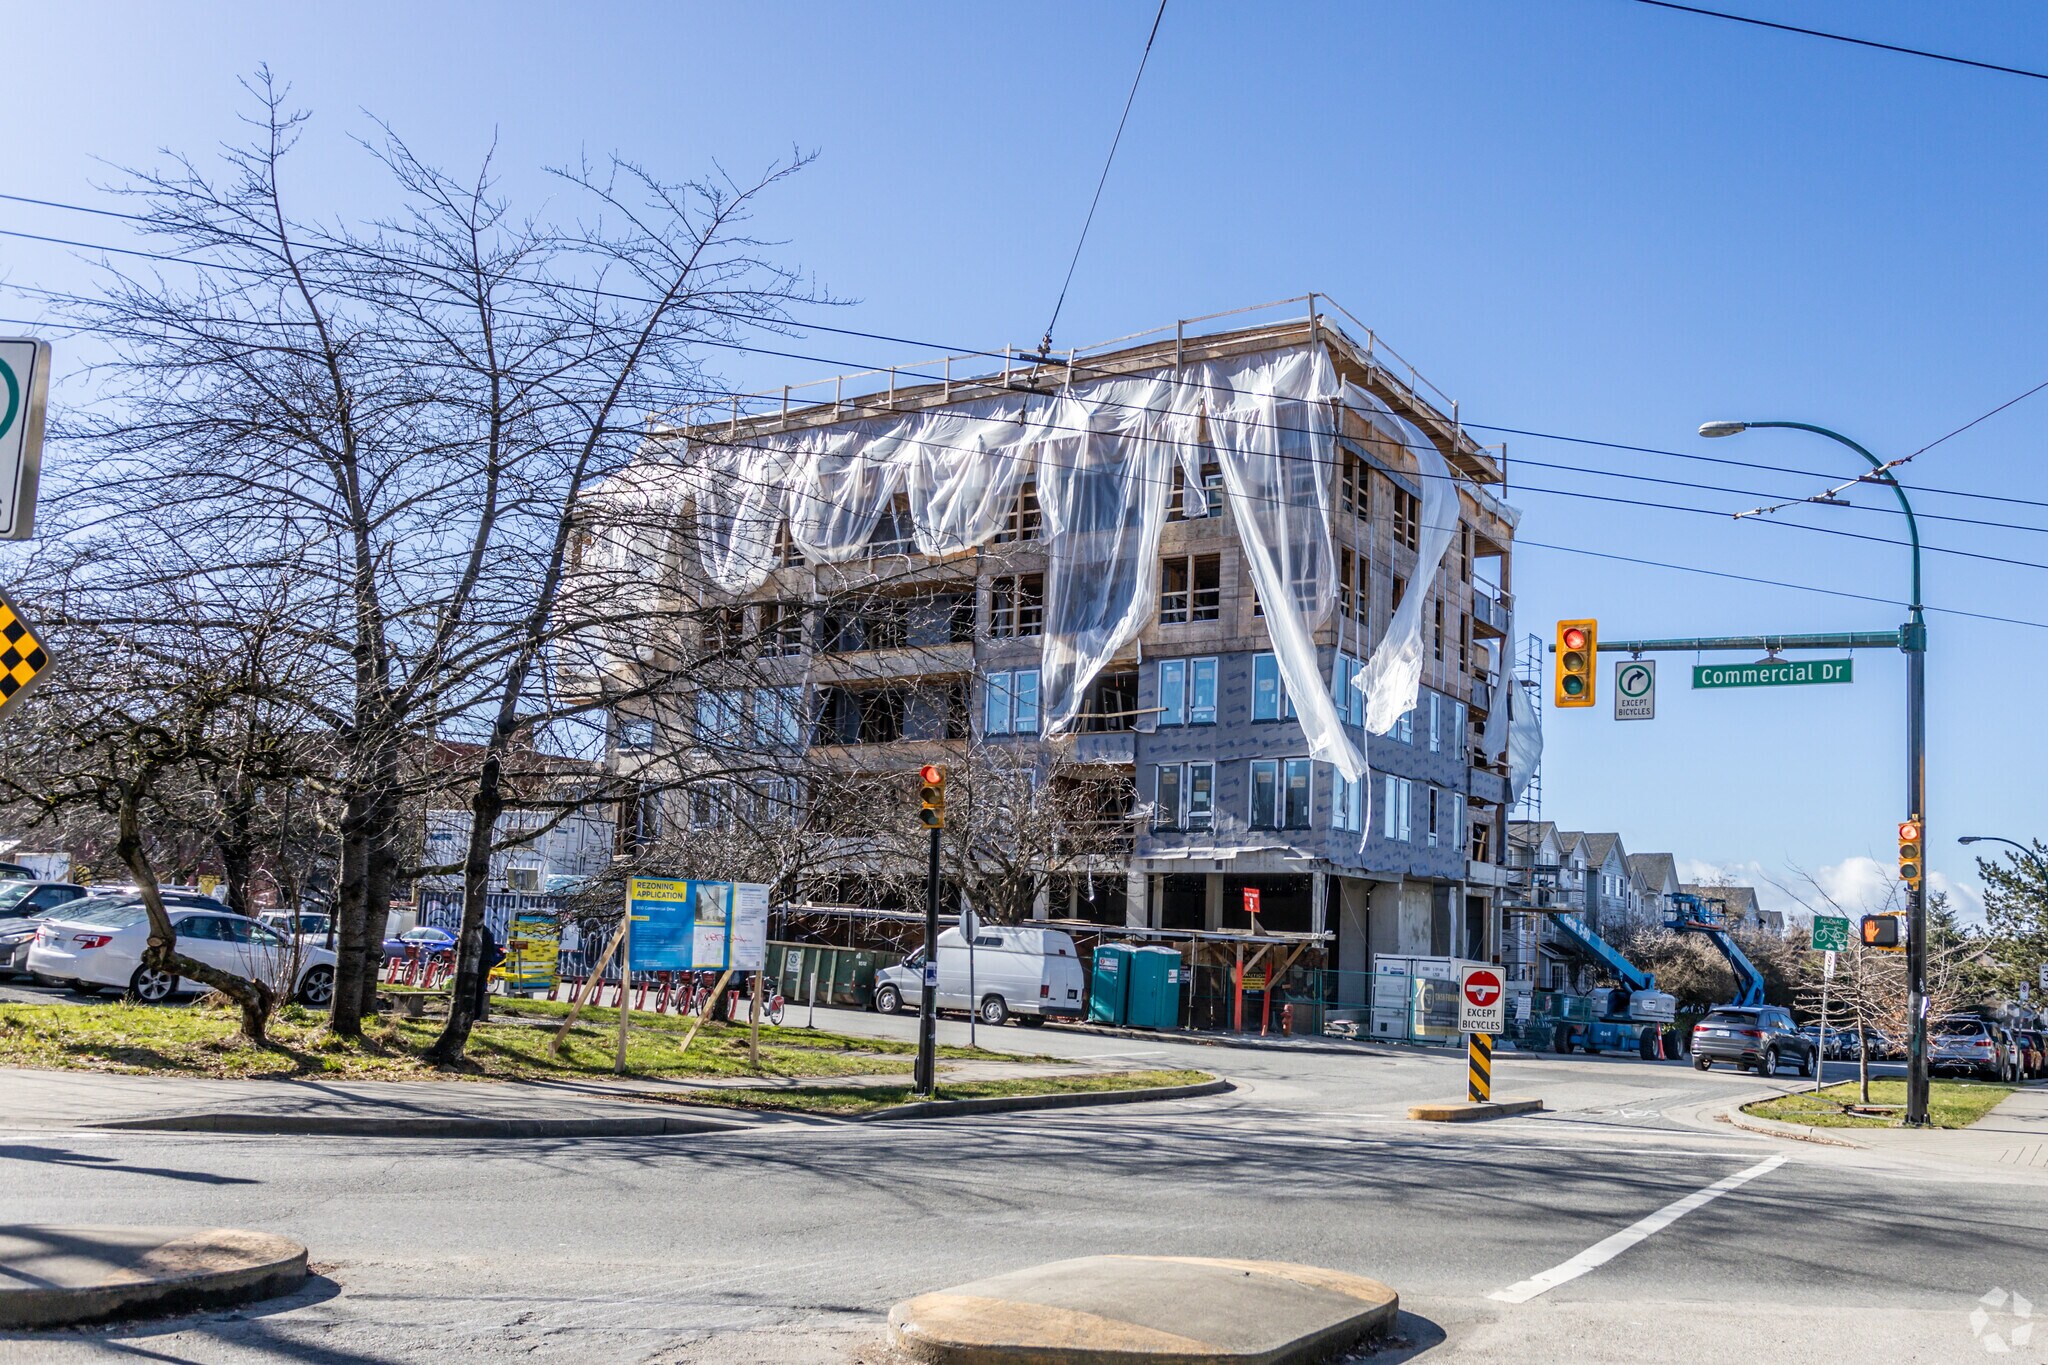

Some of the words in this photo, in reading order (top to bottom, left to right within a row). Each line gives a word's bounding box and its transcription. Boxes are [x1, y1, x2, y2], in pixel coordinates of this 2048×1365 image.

[1701, 664, 1813, 685] Commercial
[1822, 663, 1843, 680] Dr
[1621, 699, 1647, 707] EXCEPT
[1618, 707, 1651, 716] BICYCLES
[636, 881, 675, 890] REZONING
[636, 890, 683, 899] APPLICATION
[1467, 1008, 1497, 1018] EXCEPT
[1462, 1020, 1500, 1030] BICYCLES
